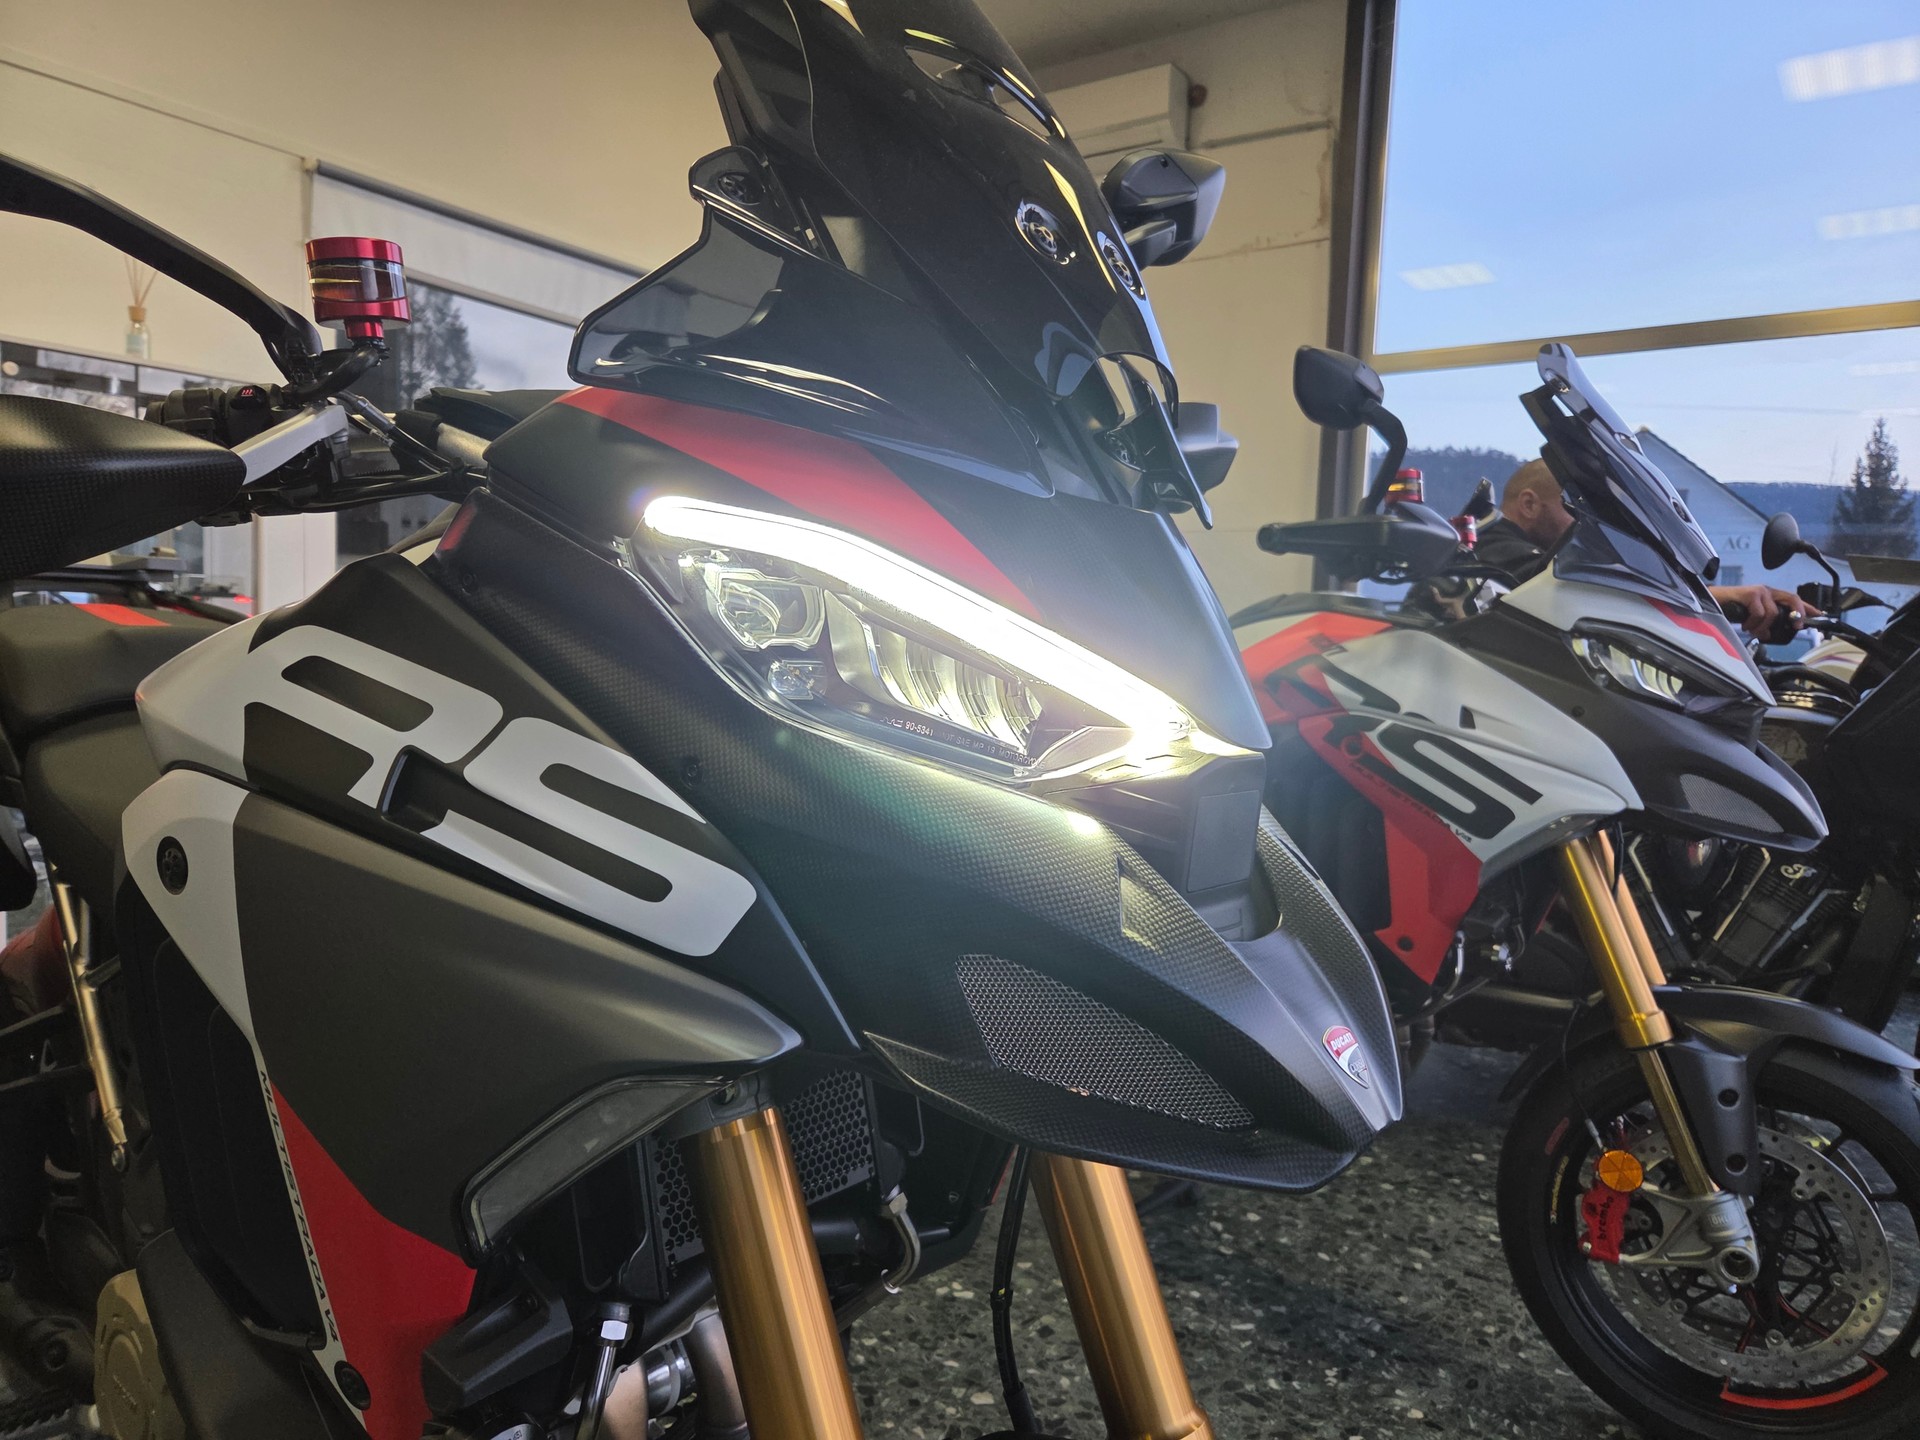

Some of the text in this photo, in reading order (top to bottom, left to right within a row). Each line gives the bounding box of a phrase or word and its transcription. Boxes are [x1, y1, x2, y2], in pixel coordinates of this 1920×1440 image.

[1722, 535, 1750, 550] AG
[955, 735, 972, 748] SAE
[1330, 1032, 1355, 1051] DUCATI
[259, 1070, 339, 1343] MULTISTRADA V4
[1597, 1196, 1615, 1241] brembo
